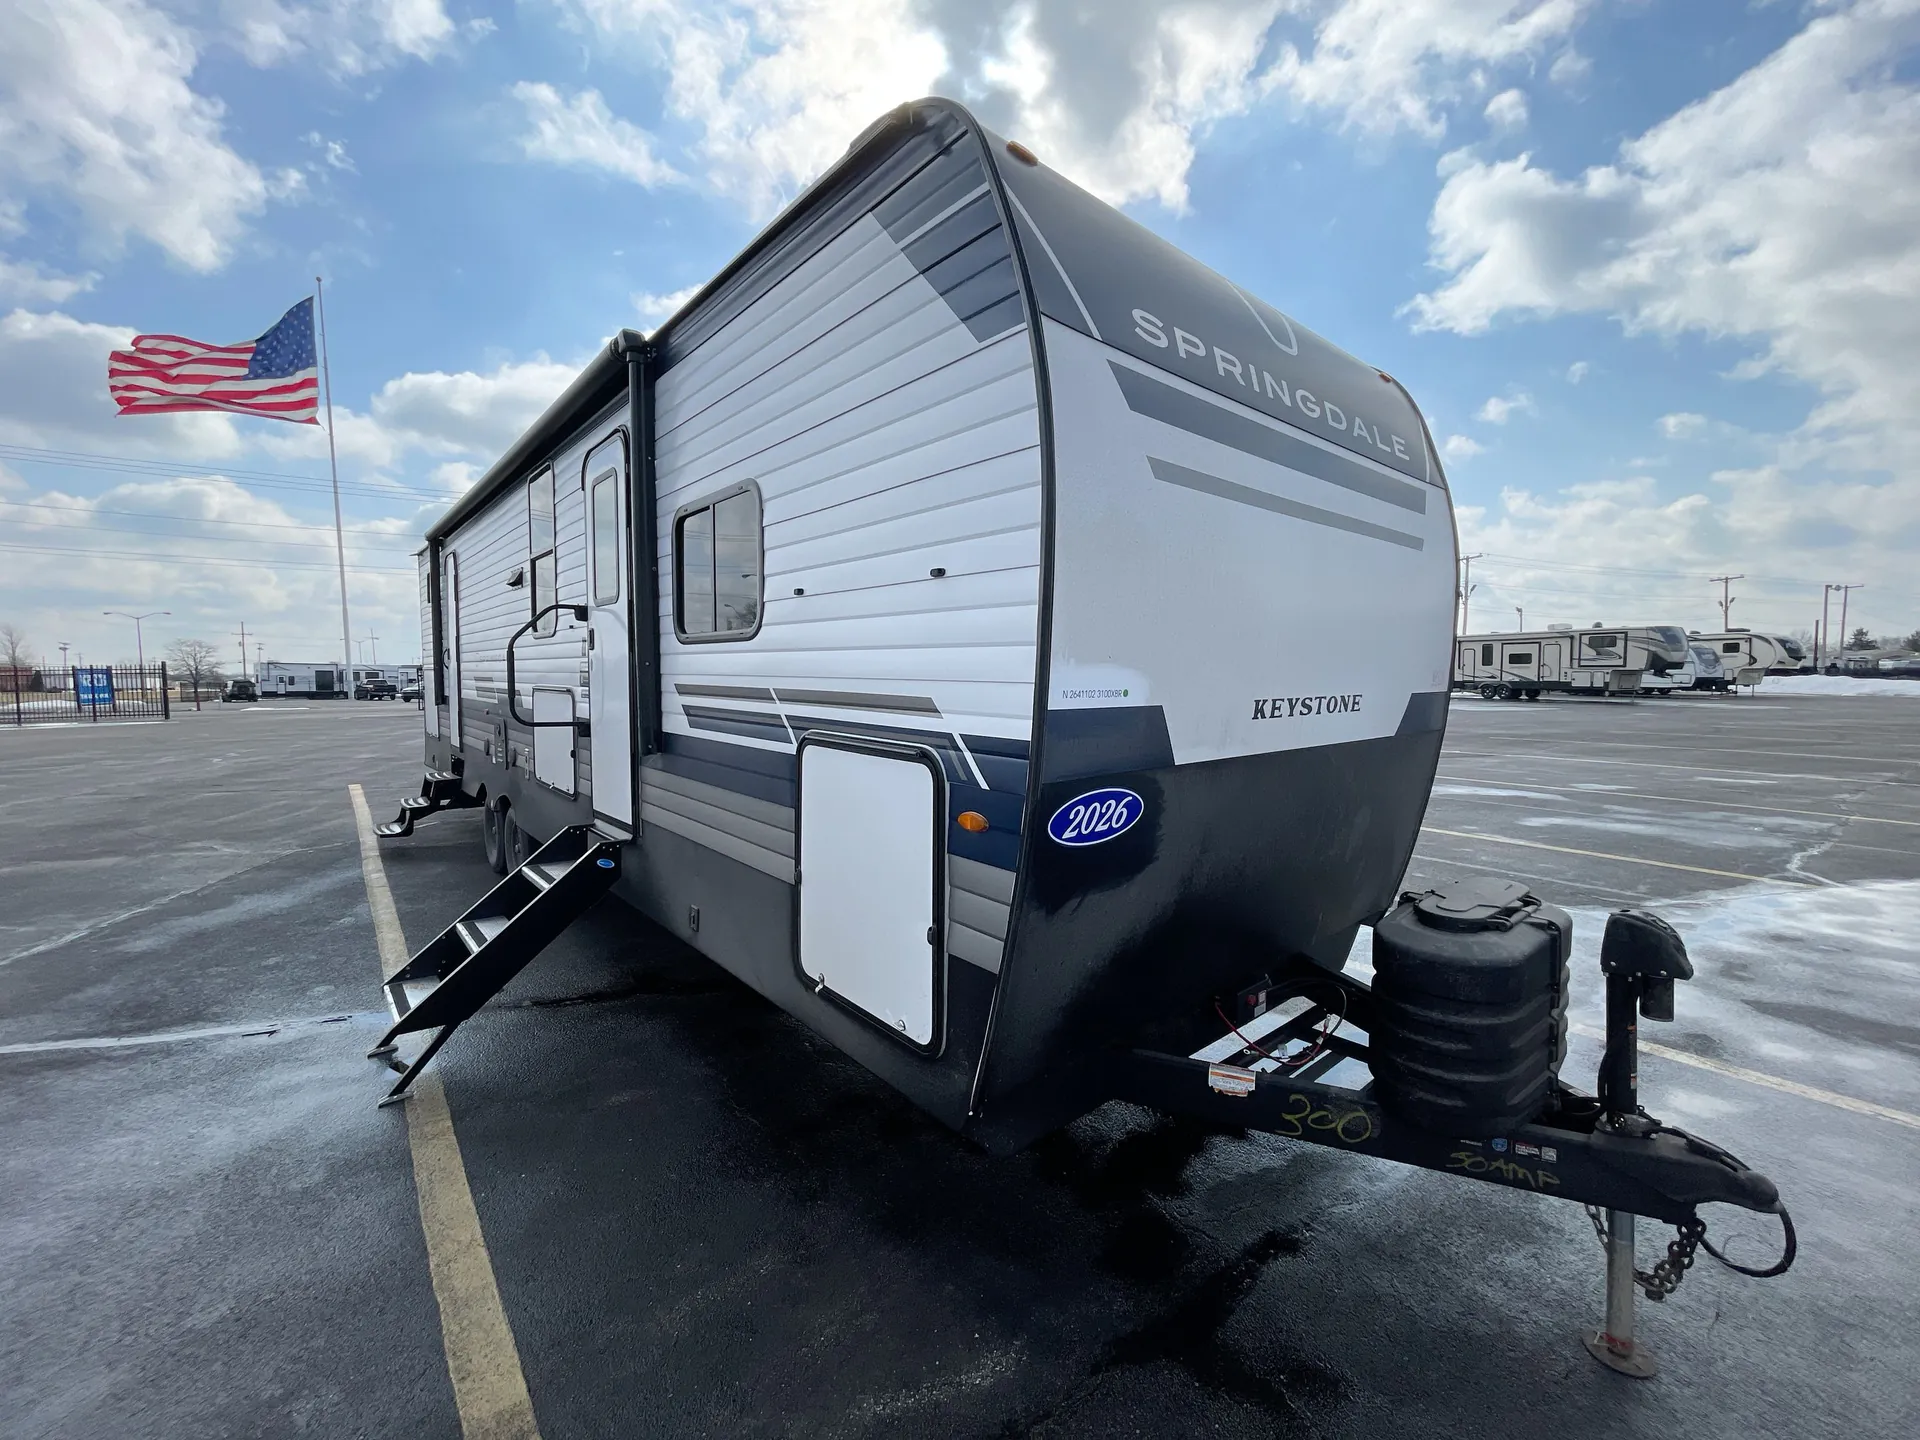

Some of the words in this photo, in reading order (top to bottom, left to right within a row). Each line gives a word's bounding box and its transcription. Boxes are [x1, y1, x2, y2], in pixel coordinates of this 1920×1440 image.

[1131, 308, 1411, 462] SPRINGDALE
[1062, 690, 1069, 699] N
[1069, 689, 1096, 699] 2641102
[1252, 694, 1364, 721] KEYSTONE
[1062, 796, 1133, 839] 2026
[1275, 1093, 1372, 1144] 300
